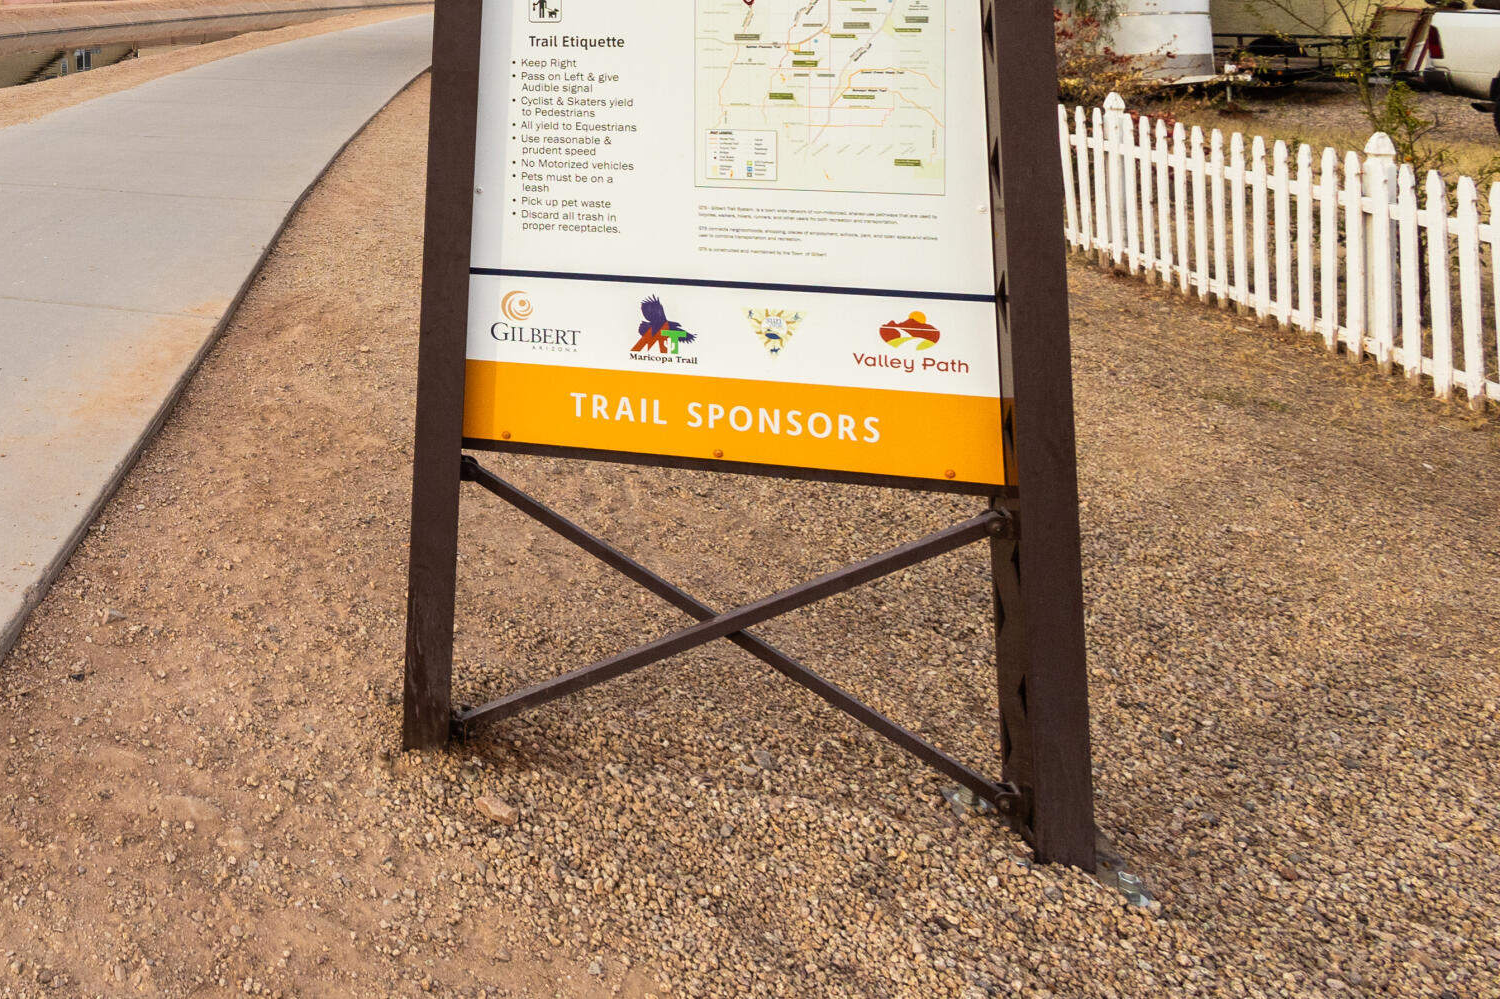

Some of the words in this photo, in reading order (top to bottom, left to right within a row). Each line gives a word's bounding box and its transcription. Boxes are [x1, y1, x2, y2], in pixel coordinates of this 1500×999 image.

[529, 36, 558, 47] Trail
[562, 36, 625, 50] Etiquette
[521, 59, 547, 68] Keep
[550, 59, 577, 69] Right
[521, 72, 545, 81] Pass
[564, 72, 584, 81] Left
[587, 73, 595, 81] &
[598, 73, 619, 83] give
[522, 83, 560, 92] Audible
[562, 84, 593, 94] signal
[521, 96, 553, 107] Cyclist
[556, 97, 564, 106] &
[567, 97, 606, 107] Skaters
[609, 98, 633, 108] yield
[522, 108, 531, 117] to
[535, 108, 595, 118] Pedestrians
[521, 121, 532, 130] All
[536, 122, 559, 131] yield
[562, 122, 572, 130] to
[575, 122, 637, 132] Equestrians
[521, 134, 540, 143] Use
[543, 135, 601, 145] reasonable
[604, 136, 612, 145] &
[522, 146, 562, 155] prudent
[565, 147, 596, 157] speed
[521, 159, 535, 168] No
[538, 159, 588, 169] Motorized
[592, 161, 634, 171] vehicles
[521, 172, 543, 181] Pets
[546, 173, 572, 182] must
[575, 174, 588, 183] be
[591, 175, 604, 183] on
[606, 176, 614, 184] a
[522, 183, 550, 192] leash
[521, 197, 542, 206] Pick
[545, 199, 558, 208] up
[561, 198, 578, 208] pet
[581, 200, 611, 209] waste
[521, 210, 560, 219] Discard
[562, 211, 574, 220] all
[577, 212, 604, 221] trash
[607, 213, 617, 222] in
[522, 222, 555, 232] proper
[558, 223, 621, 233] receptacles.
[490, 321, 581, 346] GILBERT
[531, 345, 579, 353] ARIZONA
[629, 353, 673, 364] Maricopa
[675, 355, 698, 365] Trail
[853, 352, 915, 373] Valley
[922, 356, 970, 374] Path
[570, 391, 667, 425] TRAIL
[686, 401, 881, 444] SPONSORS
